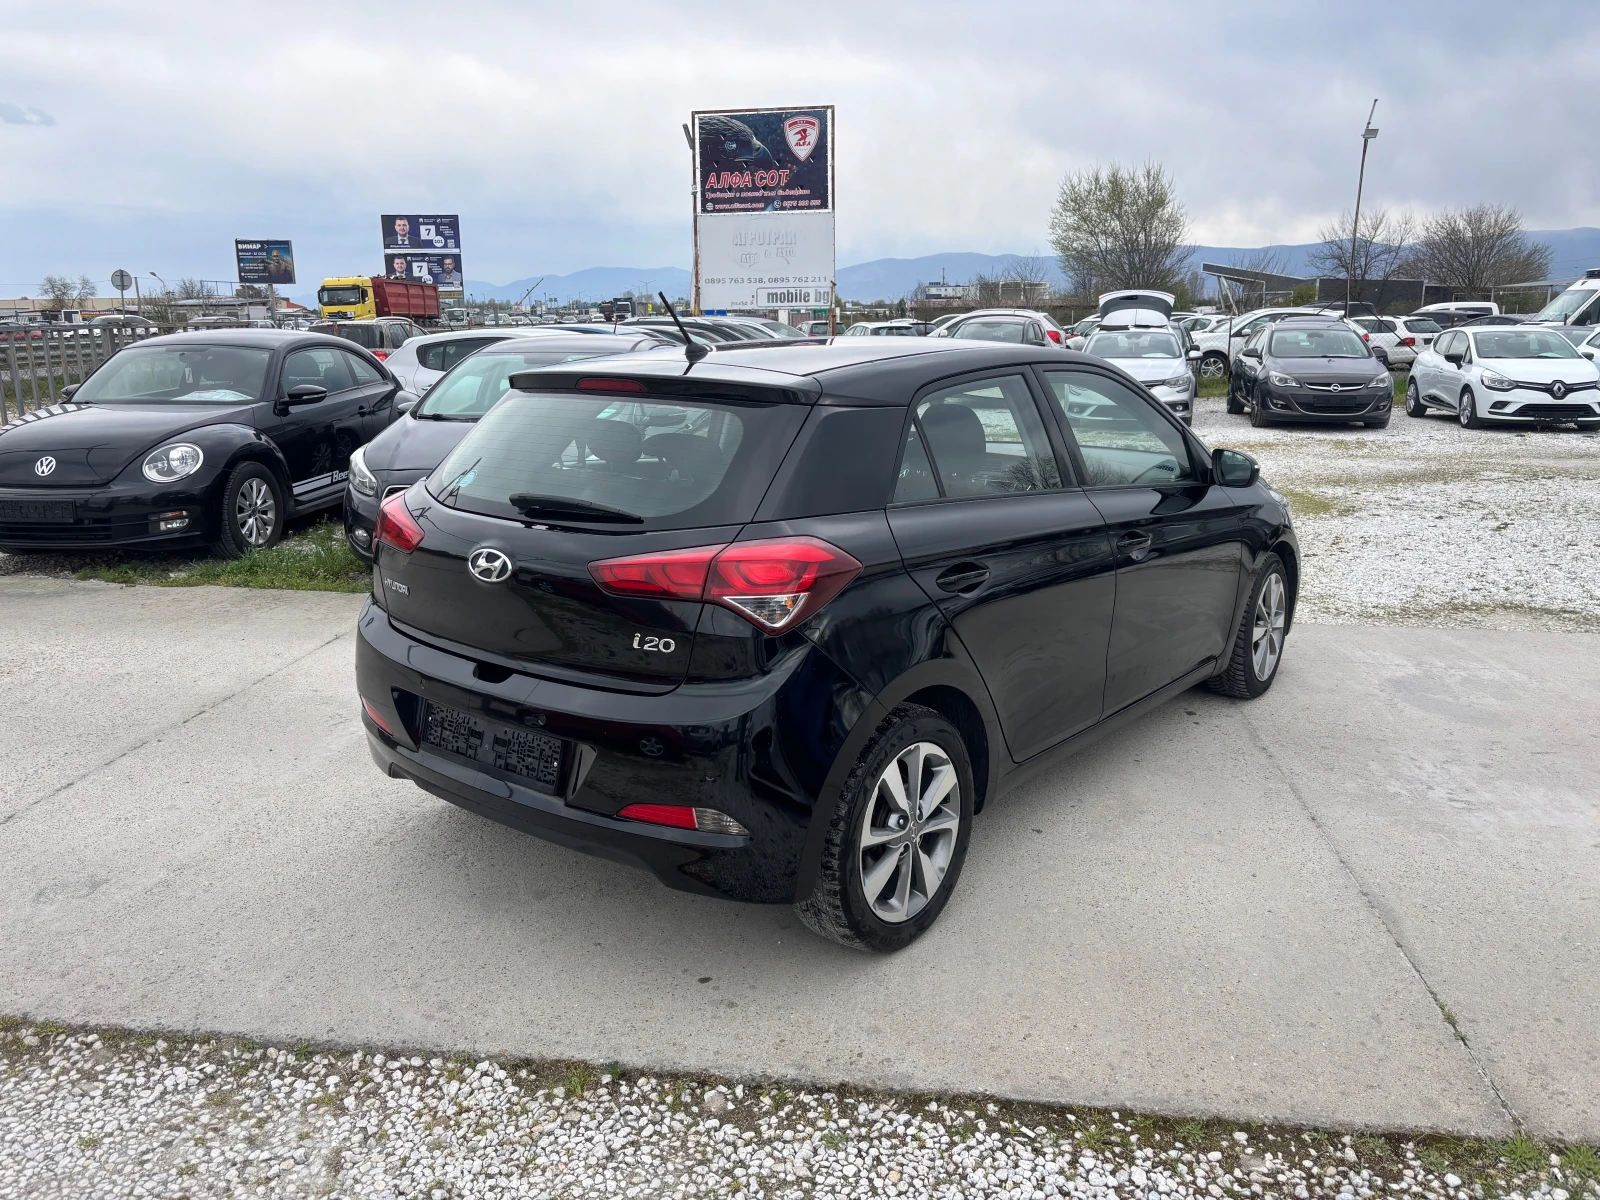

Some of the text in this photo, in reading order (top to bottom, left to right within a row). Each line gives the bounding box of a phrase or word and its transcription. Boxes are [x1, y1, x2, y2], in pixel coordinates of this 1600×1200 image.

[705, 169, 790, 189] АЛФА СОТ
[425, 228, 432, 237] 7
[416, 265, 424, 274] 7
[768, 276, 790, 284] 0895
[811, 275, 827, 283] 211
[766, 288, 811, 304] mobile
[814, 288, 830, 305] bg
[633, 633, 676, 653] i20
